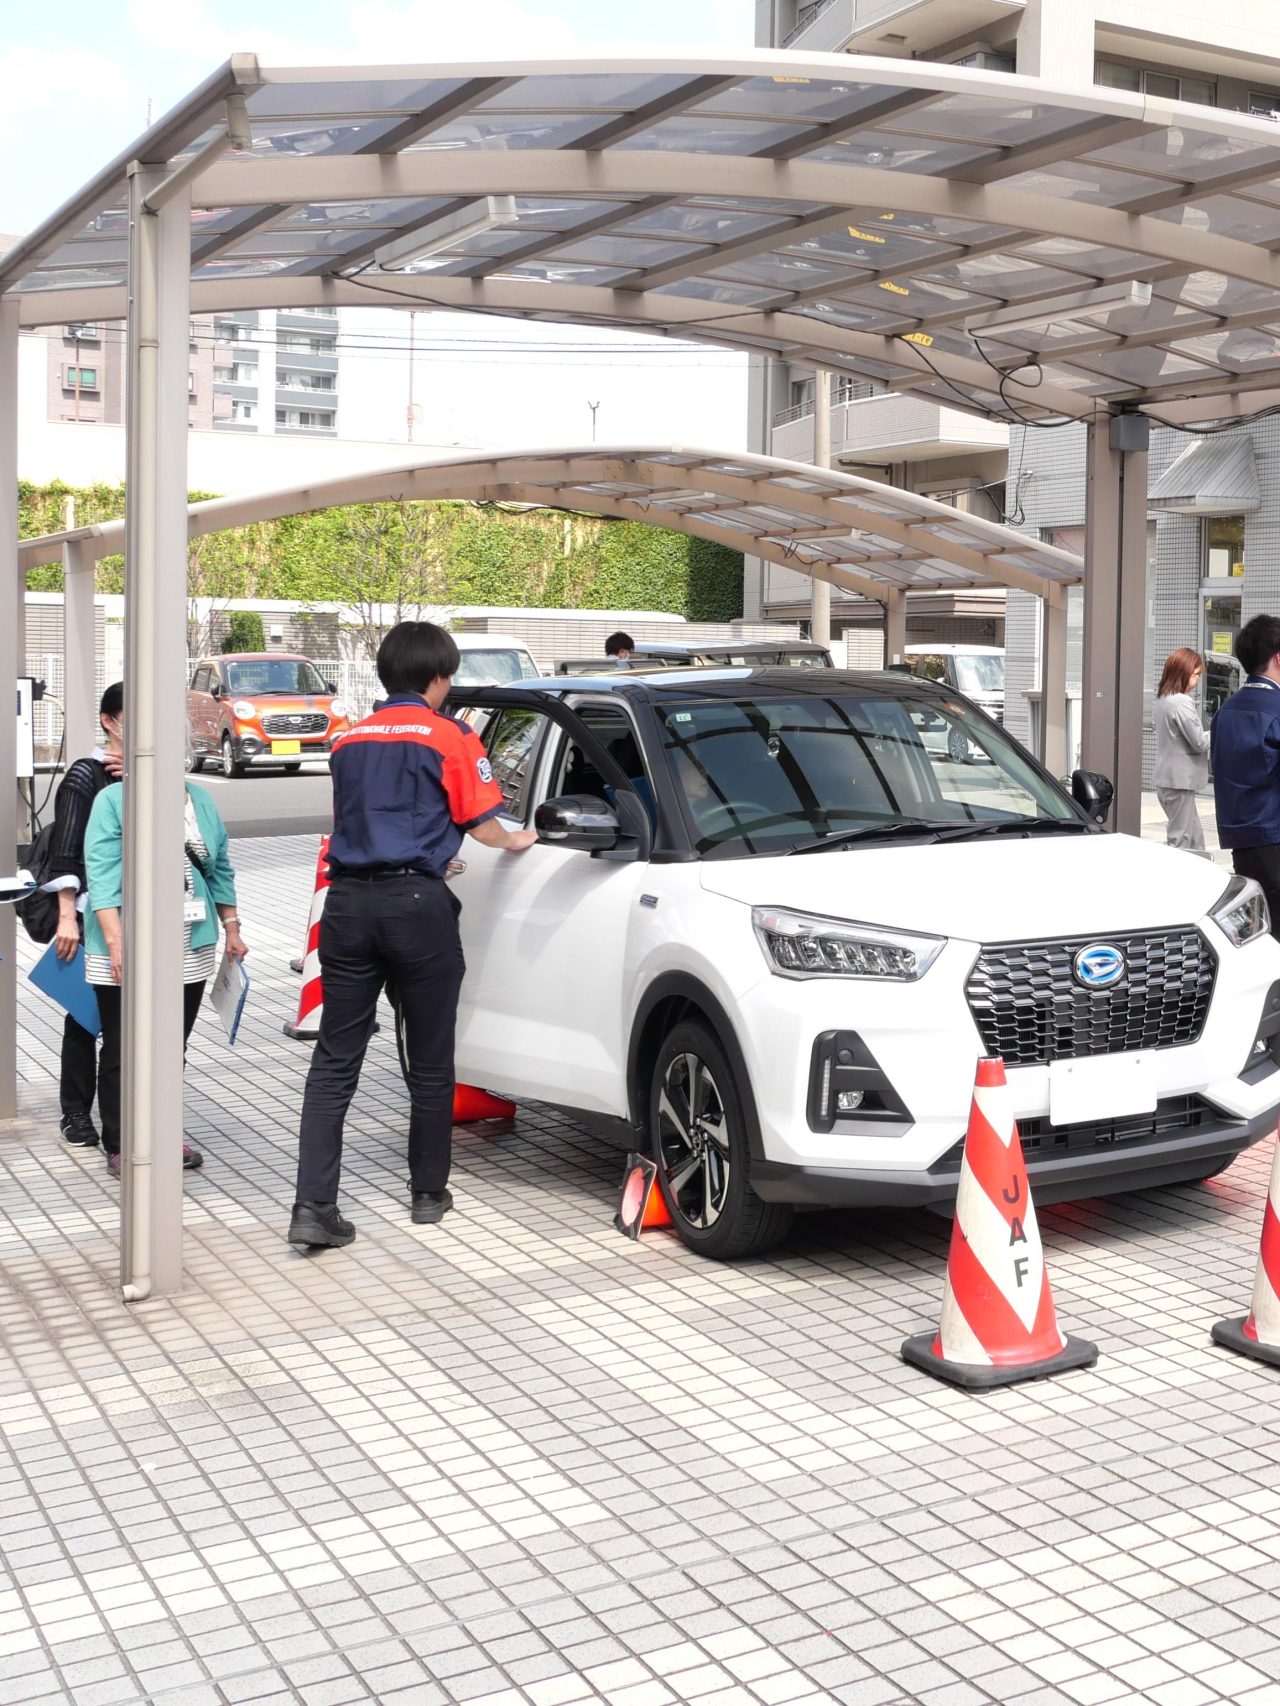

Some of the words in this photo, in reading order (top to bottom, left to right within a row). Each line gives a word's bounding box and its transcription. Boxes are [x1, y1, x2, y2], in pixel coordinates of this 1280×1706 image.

[349, 725, 391, 735] AUTOMOBILE
[391, 724, 433, 736] FEDERATION
[1002, 1173, 1029, 1289] JAF
